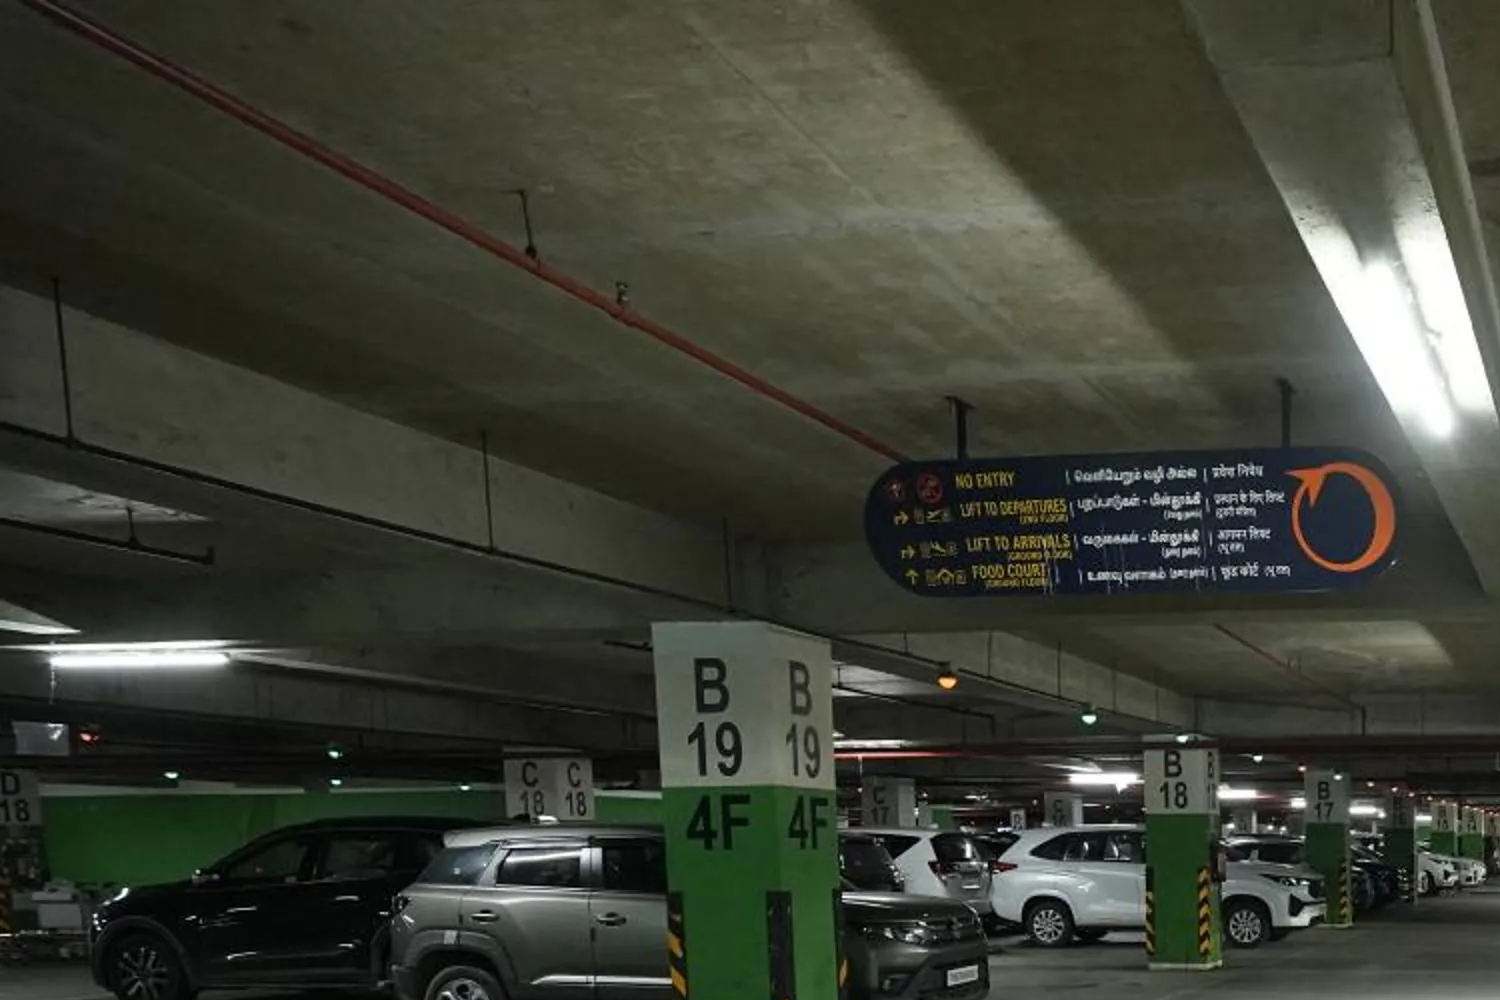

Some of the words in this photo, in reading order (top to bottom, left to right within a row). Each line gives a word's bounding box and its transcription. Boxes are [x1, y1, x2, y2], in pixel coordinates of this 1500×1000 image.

[955, 473, 973, 489] NO
[976, 470, 1016, 488] ENTRY
[960, 502, 982, 517] LIFT
[984, 501, 999, 516] TO
[1000, 498, 1067, 516] DEPARTURES
[965, 537, 989, 553] LIFT
[994, 536, 1008, 550] TO
[1013, 533, 1071, 550] ARRIVALS
[971, 565, 1004, 581] FOOD
[1007, 562, 1046, 579] COURT
[694, 657, 730, 713] B
[788, 660, 813, 716] B
[687, 721, 743, 777] 19
[785, 723, 821, 778] 19
[522, 762, 538, 787] C
[567, 762, 580, 787] C
[1164, 751, 1182, 777] B
[2, 772, 20, 795] D
[873, 786, 885, 804] C
[1160, 782, 1187, 808] 18
[1318, 782, 1330, 800] B
[0, 799, 30, 822] 18
[520, 790, 545, 815] 18
[565, 791, 587, 816] 18
[1314, 802, 1334, 820] 17
[686, 794, 750, 850] 4F
[788, 795, 828, 850] 4F
